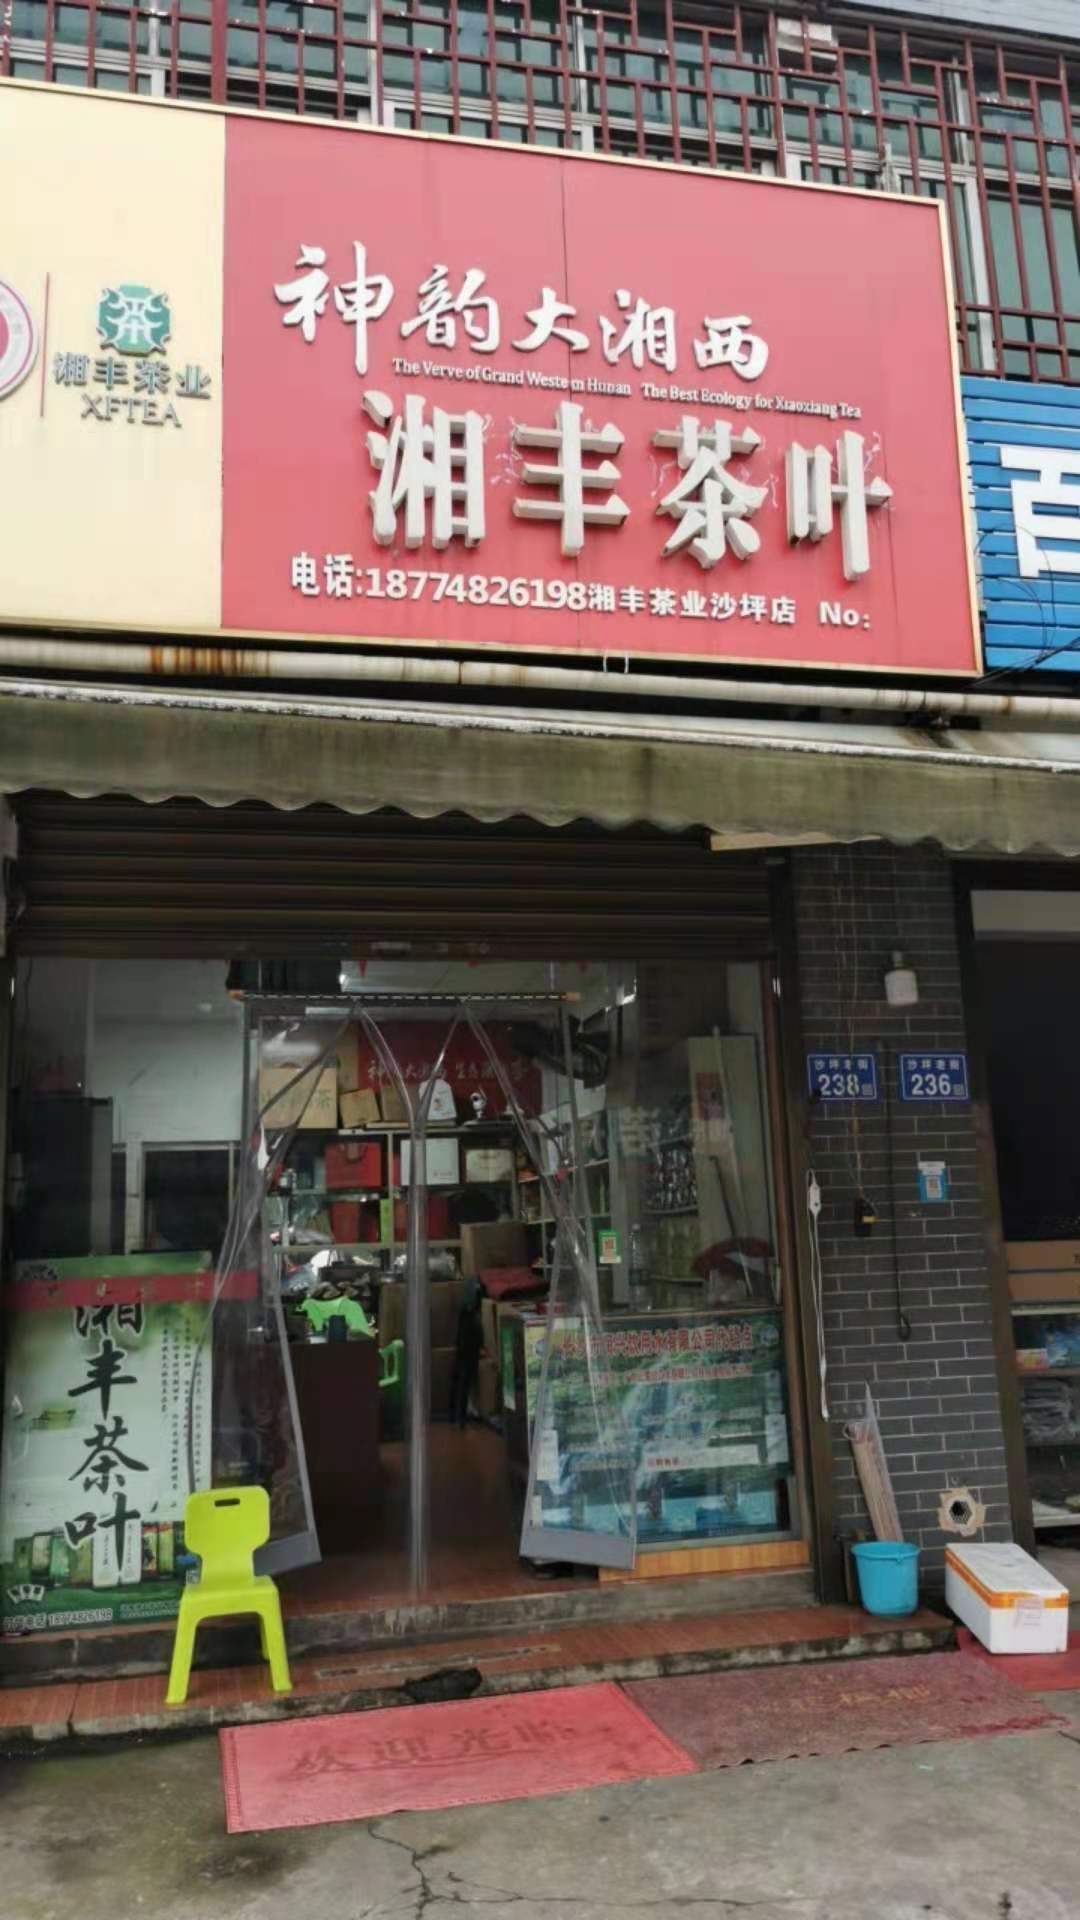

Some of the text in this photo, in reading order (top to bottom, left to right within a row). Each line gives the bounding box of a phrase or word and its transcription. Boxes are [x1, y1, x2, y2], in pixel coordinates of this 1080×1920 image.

[274, 240, 769, 380] 神韵大湘西
[53, 352, 211, 399] 湘丰茶业
[393, 357, 420, 374] The
[422, 361, 463, 378] Verve
[466, 364, 481, 379] of
[482, 366, 524, 385] Grand
[587, 377, 632, 395] Hunan
[81, 393, 182, 428] XFTEA
[642, 383, 862, 419] The Best Ecology for Xiaoxiang Tea
[362, 391, 894, 581] 湘丰茶叶
[819, 600, 870, 630] No:
[818, 1073, 860, 1096] 238
[911, 1073, 951, 1096] 236
